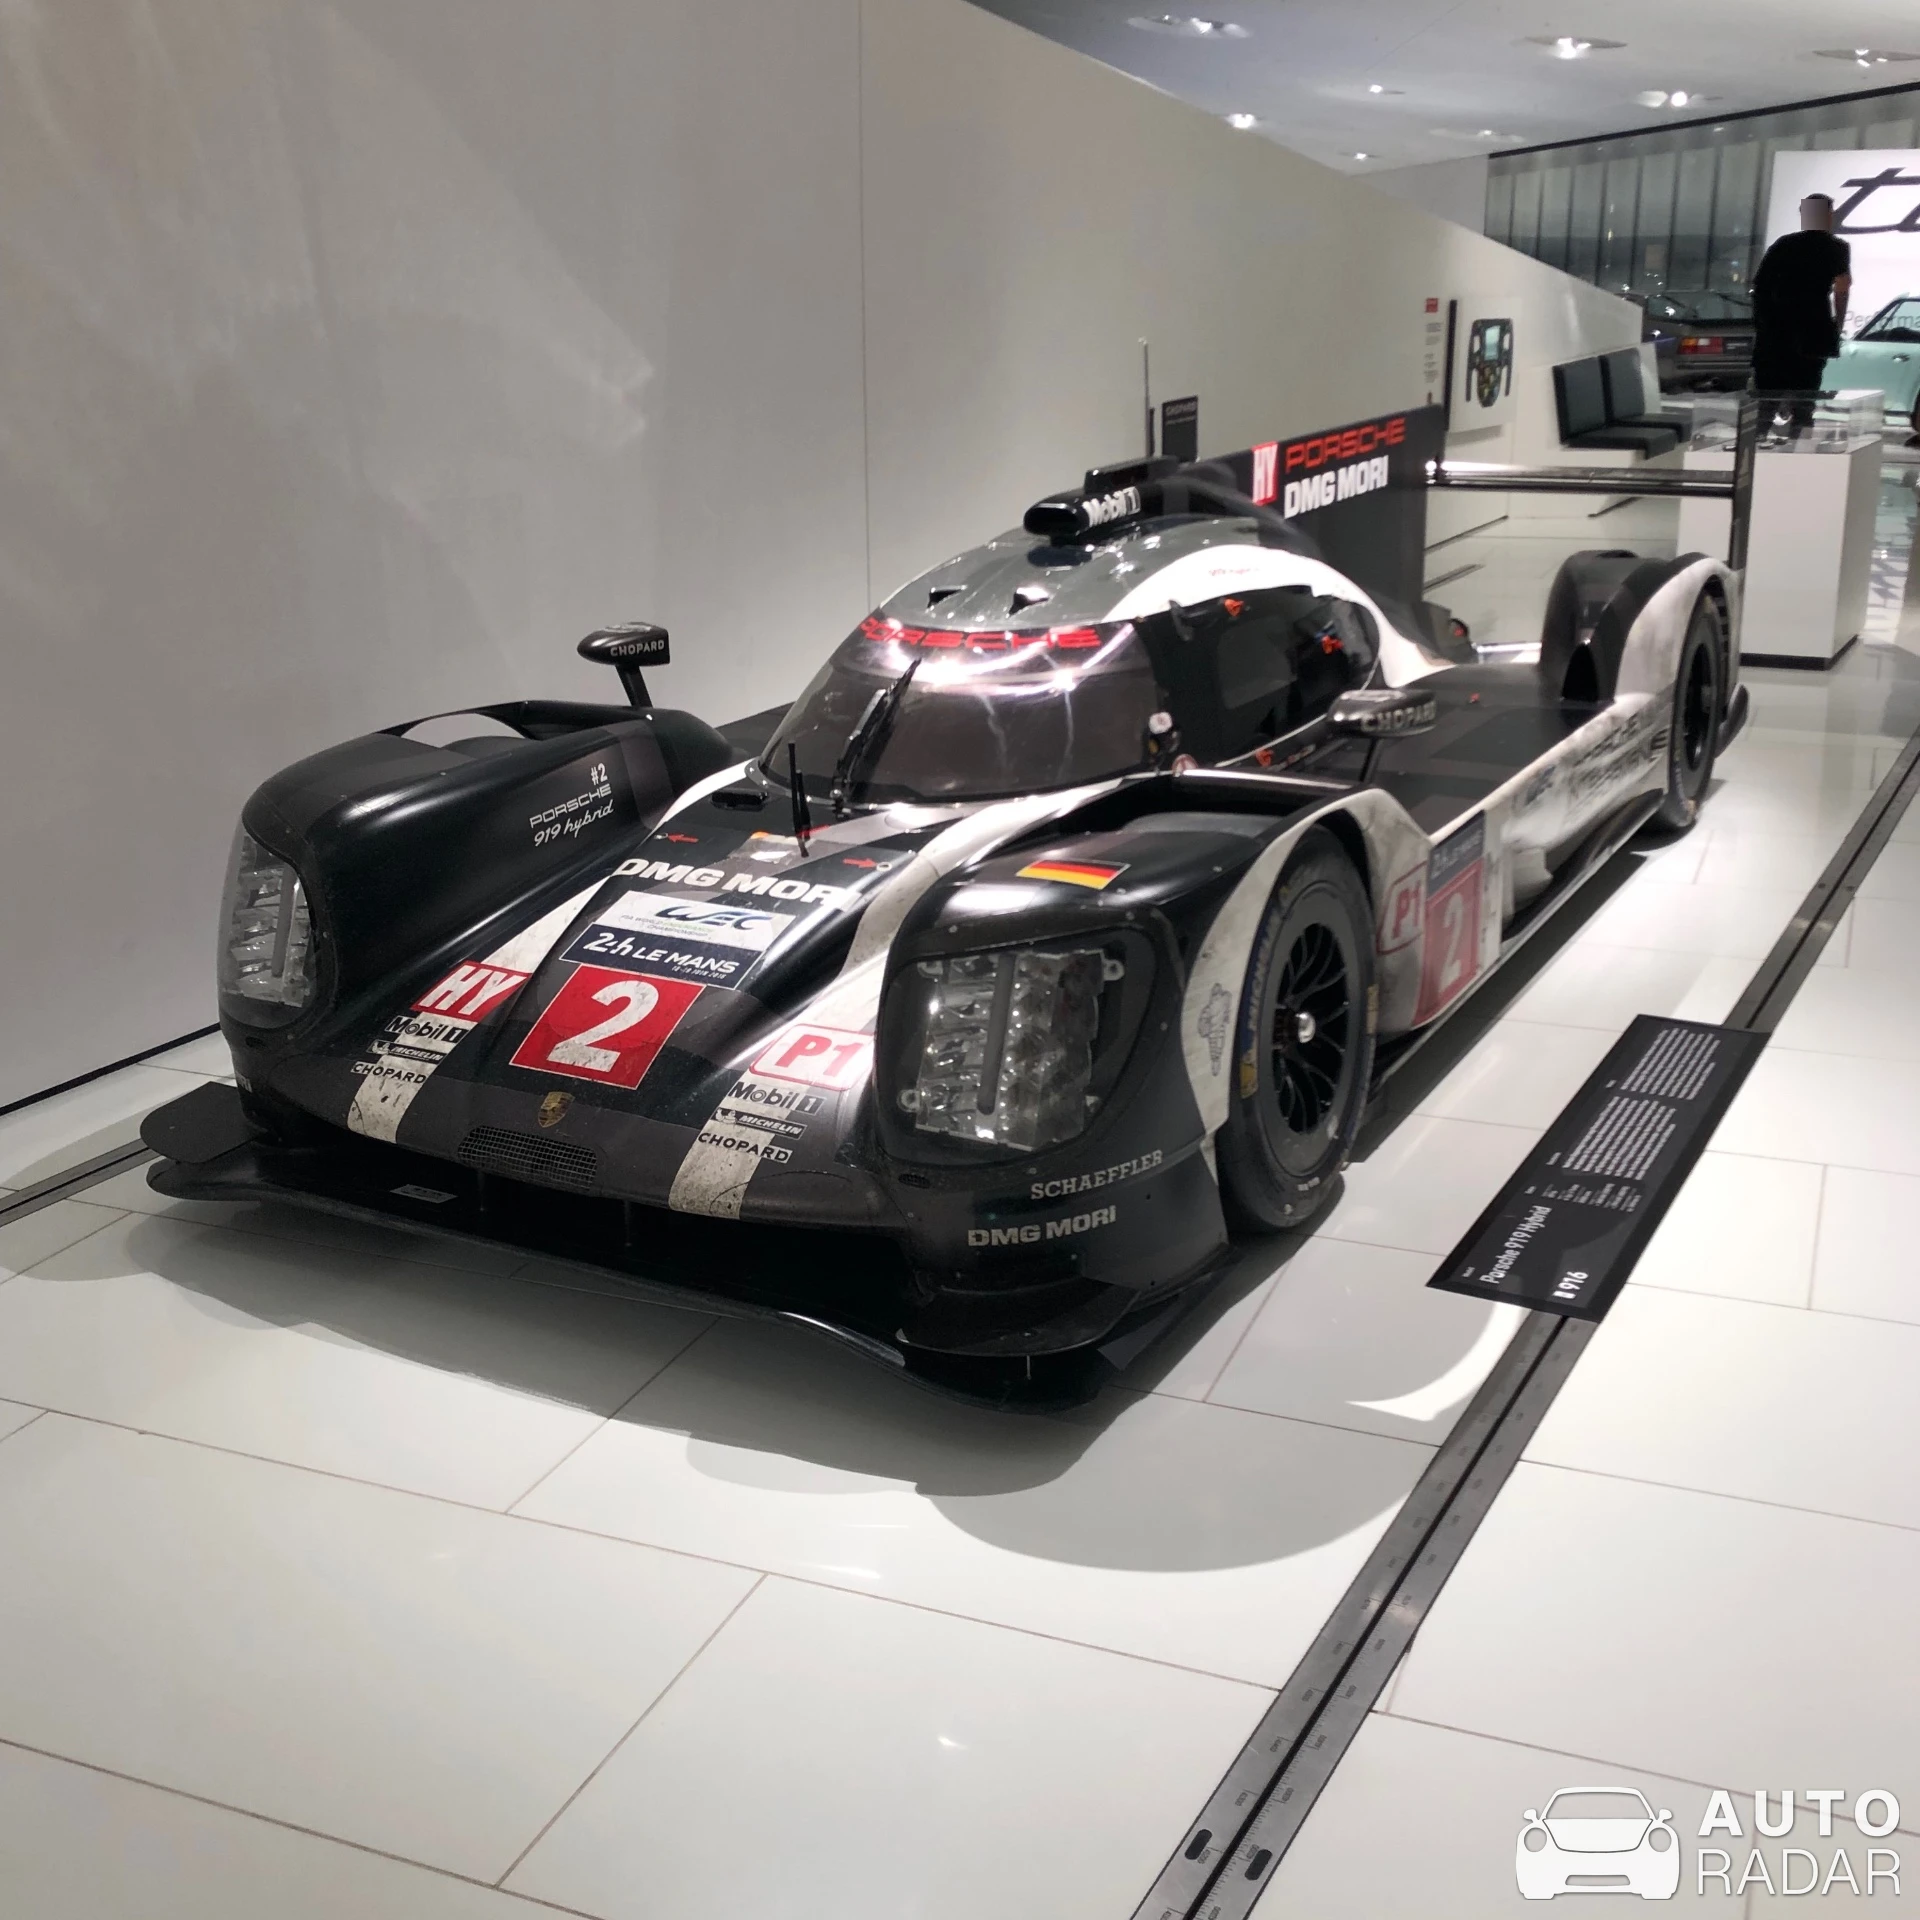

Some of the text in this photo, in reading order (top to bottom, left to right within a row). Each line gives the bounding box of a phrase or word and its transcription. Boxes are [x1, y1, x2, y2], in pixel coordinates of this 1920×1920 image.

[1285, 417, 1405, 474] PORSCHE
[1253, 443, 1279, 503] HY
[1284, 455, 1389, 520] DMG MORI
[1082, 489, 1127, 527] Mobil
[610, 639, 665, 657] CHOPARD
[859, 617, 1101, 650] PORSCHE
[590, 762, 609, 786] #2
[529, 783, 612, 829] PORSCHE
[533, 799, 614, 847] 919 hybrid
[612, 858, 725, 888] DMG
[655, 905, 773, 931] WEC
[1440, 891, 1464, 993] 2
[632, 946, 668, 961] LE
[663, 951, 740, 974] MANS
[418, 964, 528, 1016] HY
[387, 1016, 445, 1041] Mobil
[546, 980, 660, 1072] 2
[391, 1046, 444, 1061] MICHELIN
[775, 1033, 865, 1078] P1
[353, 1063, 427, 1084] CHOPARD
[728, 1081, 799, 1110] Mobil
[737, 1114, 803, 1136] MICHELIN
[697, 1132, 790, 1163] CHOPARD
[1030, 1149, 1164, 1200] SCHAEFFLER
[967, 1205, 1117, 1247] DMG MORI
[1479, 1205, 1553, 1284] Porsche 919 Hybrid
[1557, 1270, 1589, 1290] 916
